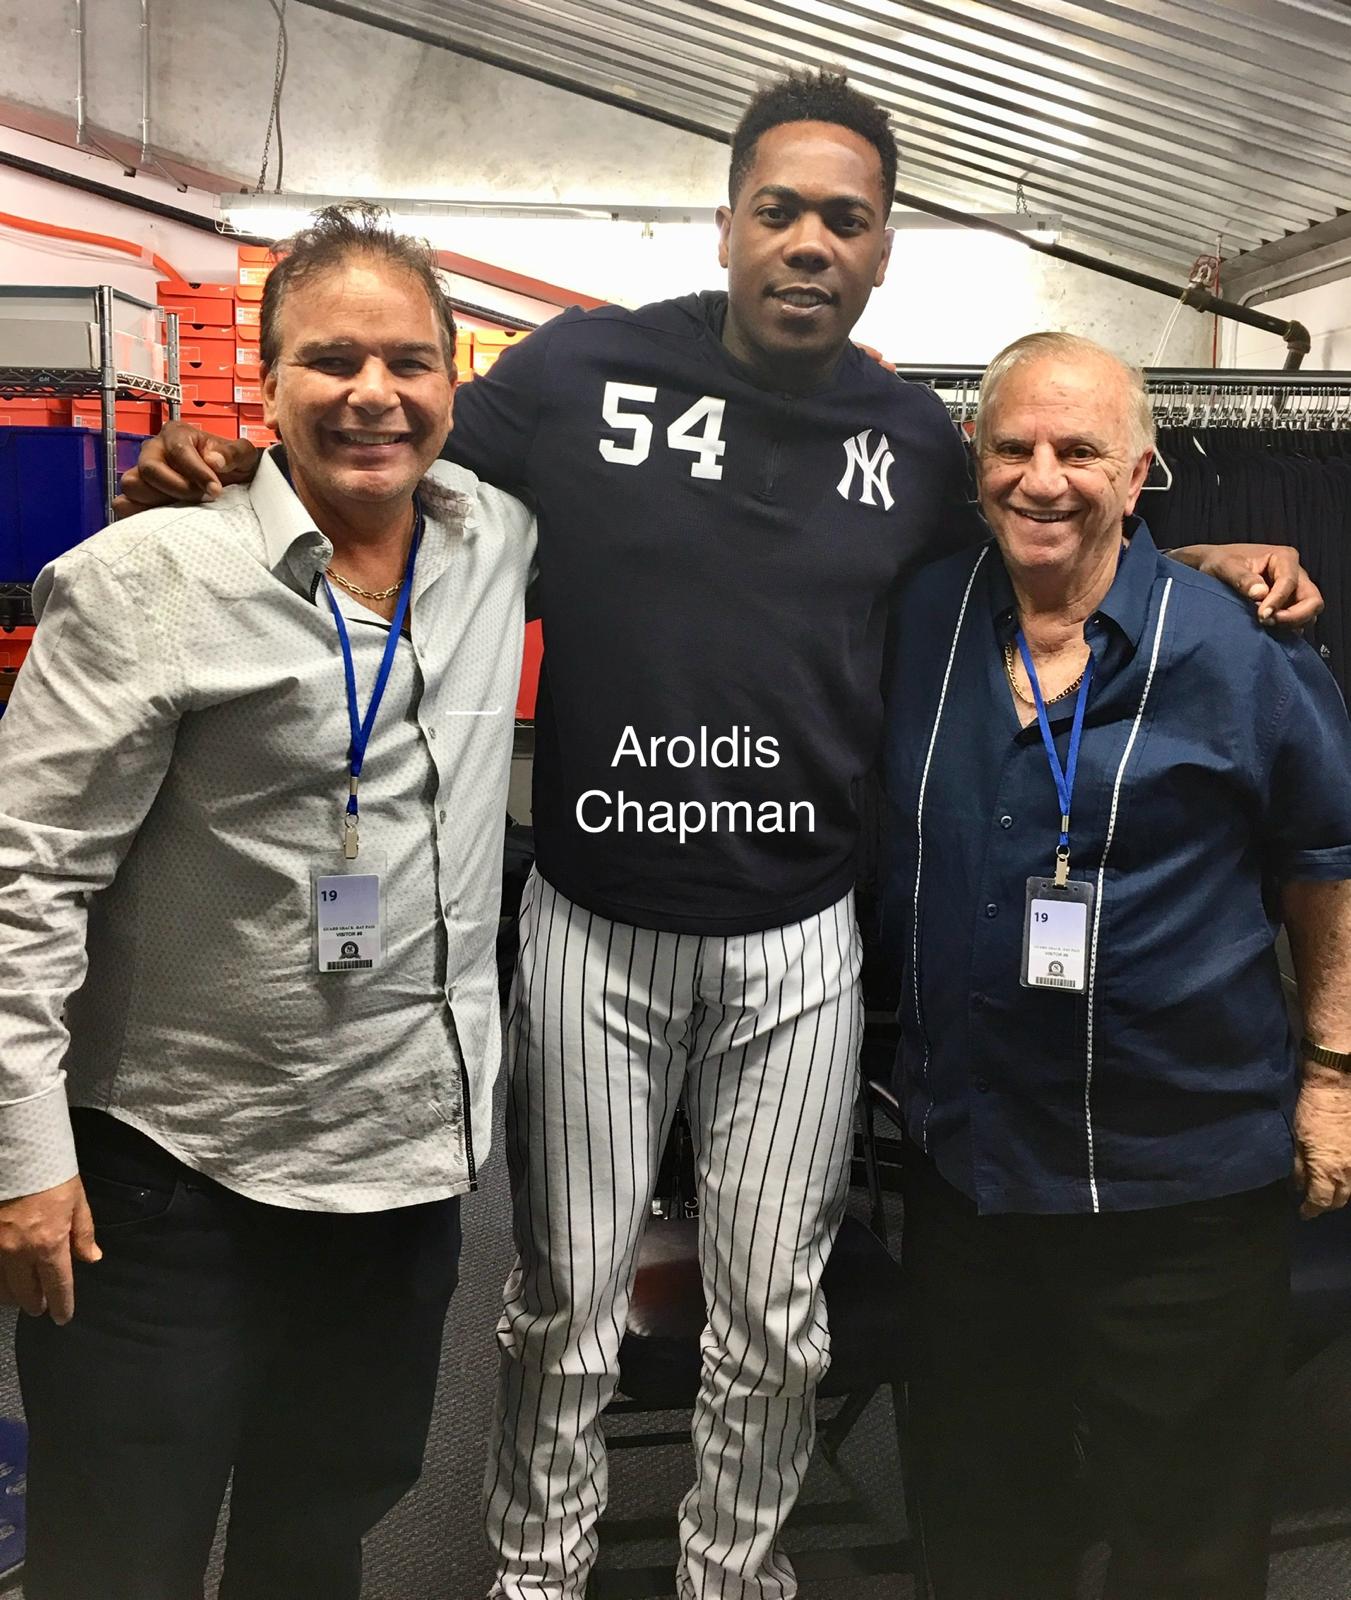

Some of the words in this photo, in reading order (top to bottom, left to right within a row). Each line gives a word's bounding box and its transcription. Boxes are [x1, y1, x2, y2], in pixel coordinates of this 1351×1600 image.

[599, 381, 725, 480] 54
[837, 429, 895, 511] NY
[321, 890, 337, 901] 19
[1034, 912, 1048, 923] 19
